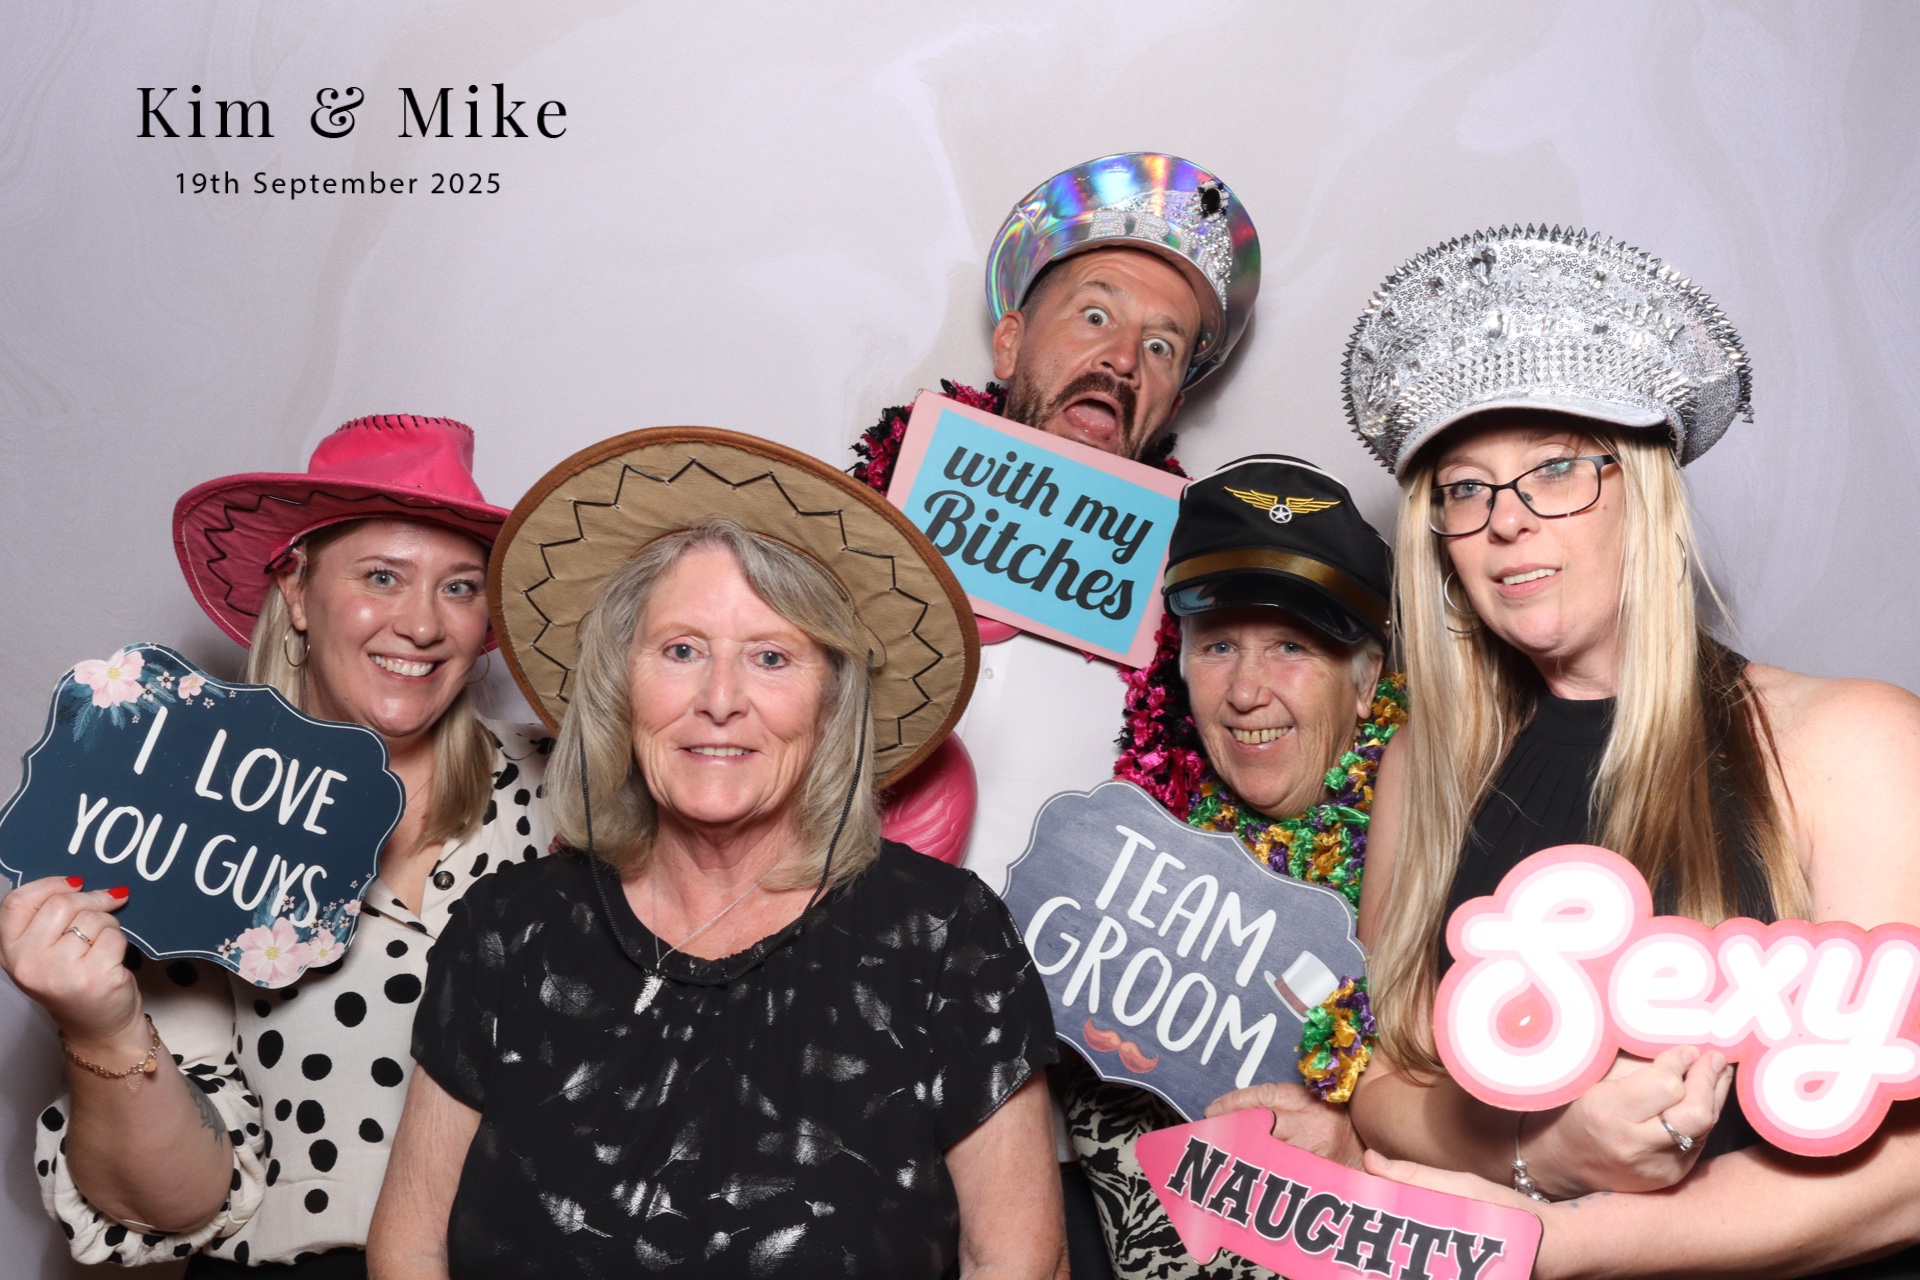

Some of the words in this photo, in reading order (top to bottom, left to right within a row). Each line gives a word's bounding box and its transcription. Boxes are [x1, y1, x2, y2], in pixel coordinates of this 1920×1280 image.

[923, 489, 1135, 621] Bitches
[943, 445, 1060, 517] with
[1063, 494, 1154, 565] my
[133, 706, 169, 775] I
[195, 729, 348, 835] LOVE
[67, 793, 188, 882] YOU
[194, 834, 328, 928] GUYS
[1095, 825, 1277, 987] TEAM
[1023, 896, 1278, 1090] GROOM
[1452, 866, 1918, 1134] Sexy
[1165, 1135, 1507, 1280] NAUGHTY
